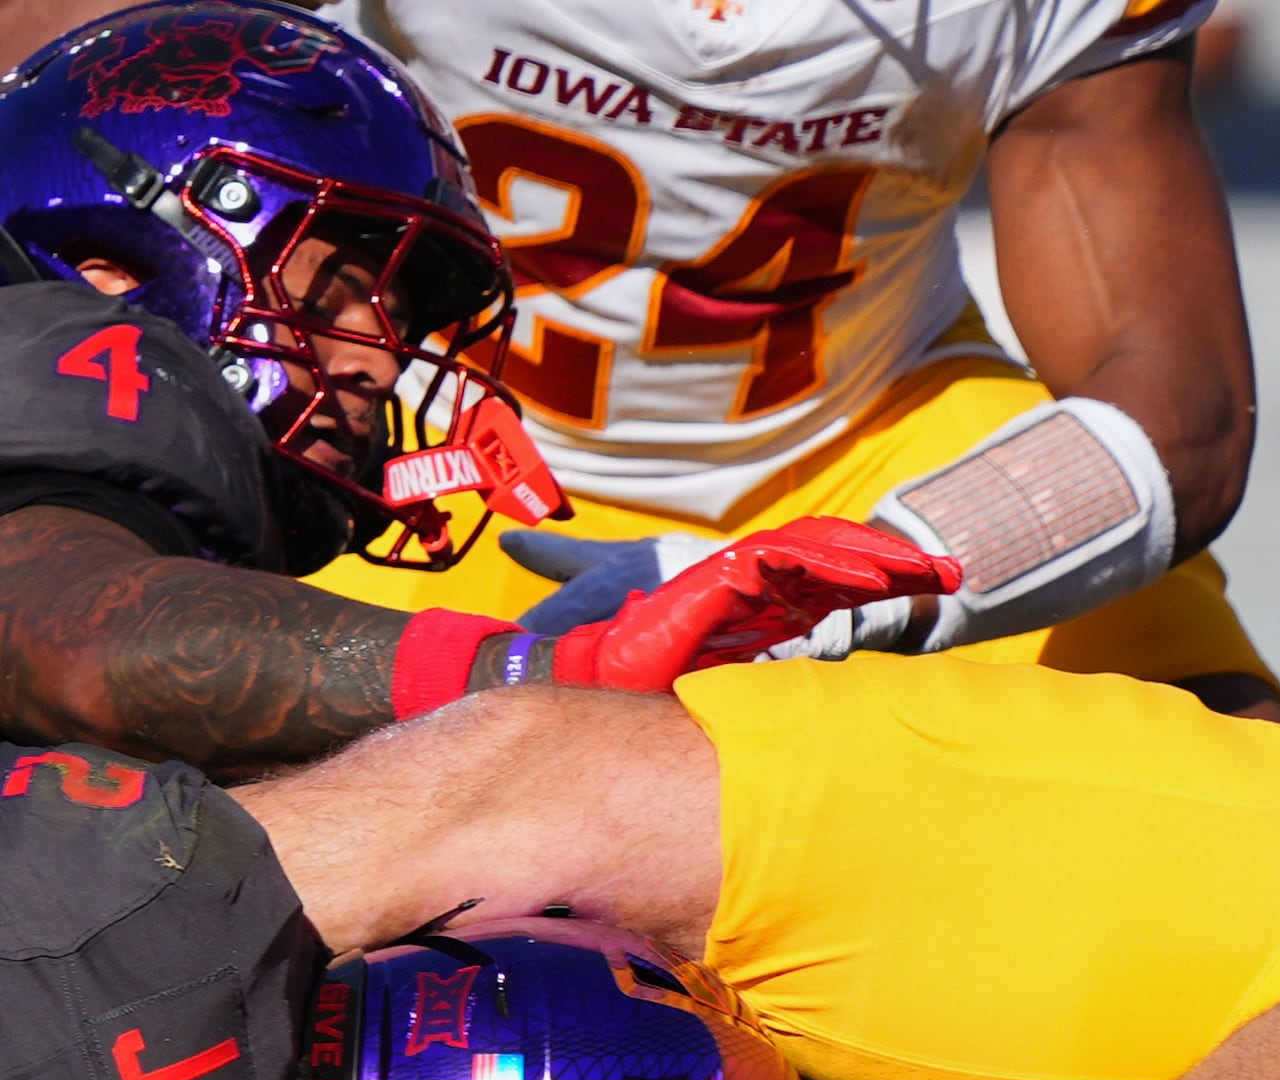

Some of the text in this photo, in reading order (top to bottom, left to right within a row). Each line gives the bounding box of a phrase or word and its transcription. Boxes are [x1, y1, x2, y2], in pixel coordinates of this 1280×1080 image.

[482, 47, 889, 155] IOWA STATE
[434, 111, 876, 430] 24
[57, 324, 149, 422] 4
[388, 448, 483, 502] NXTRND
[311, 983, 351, 1068] GIVE
